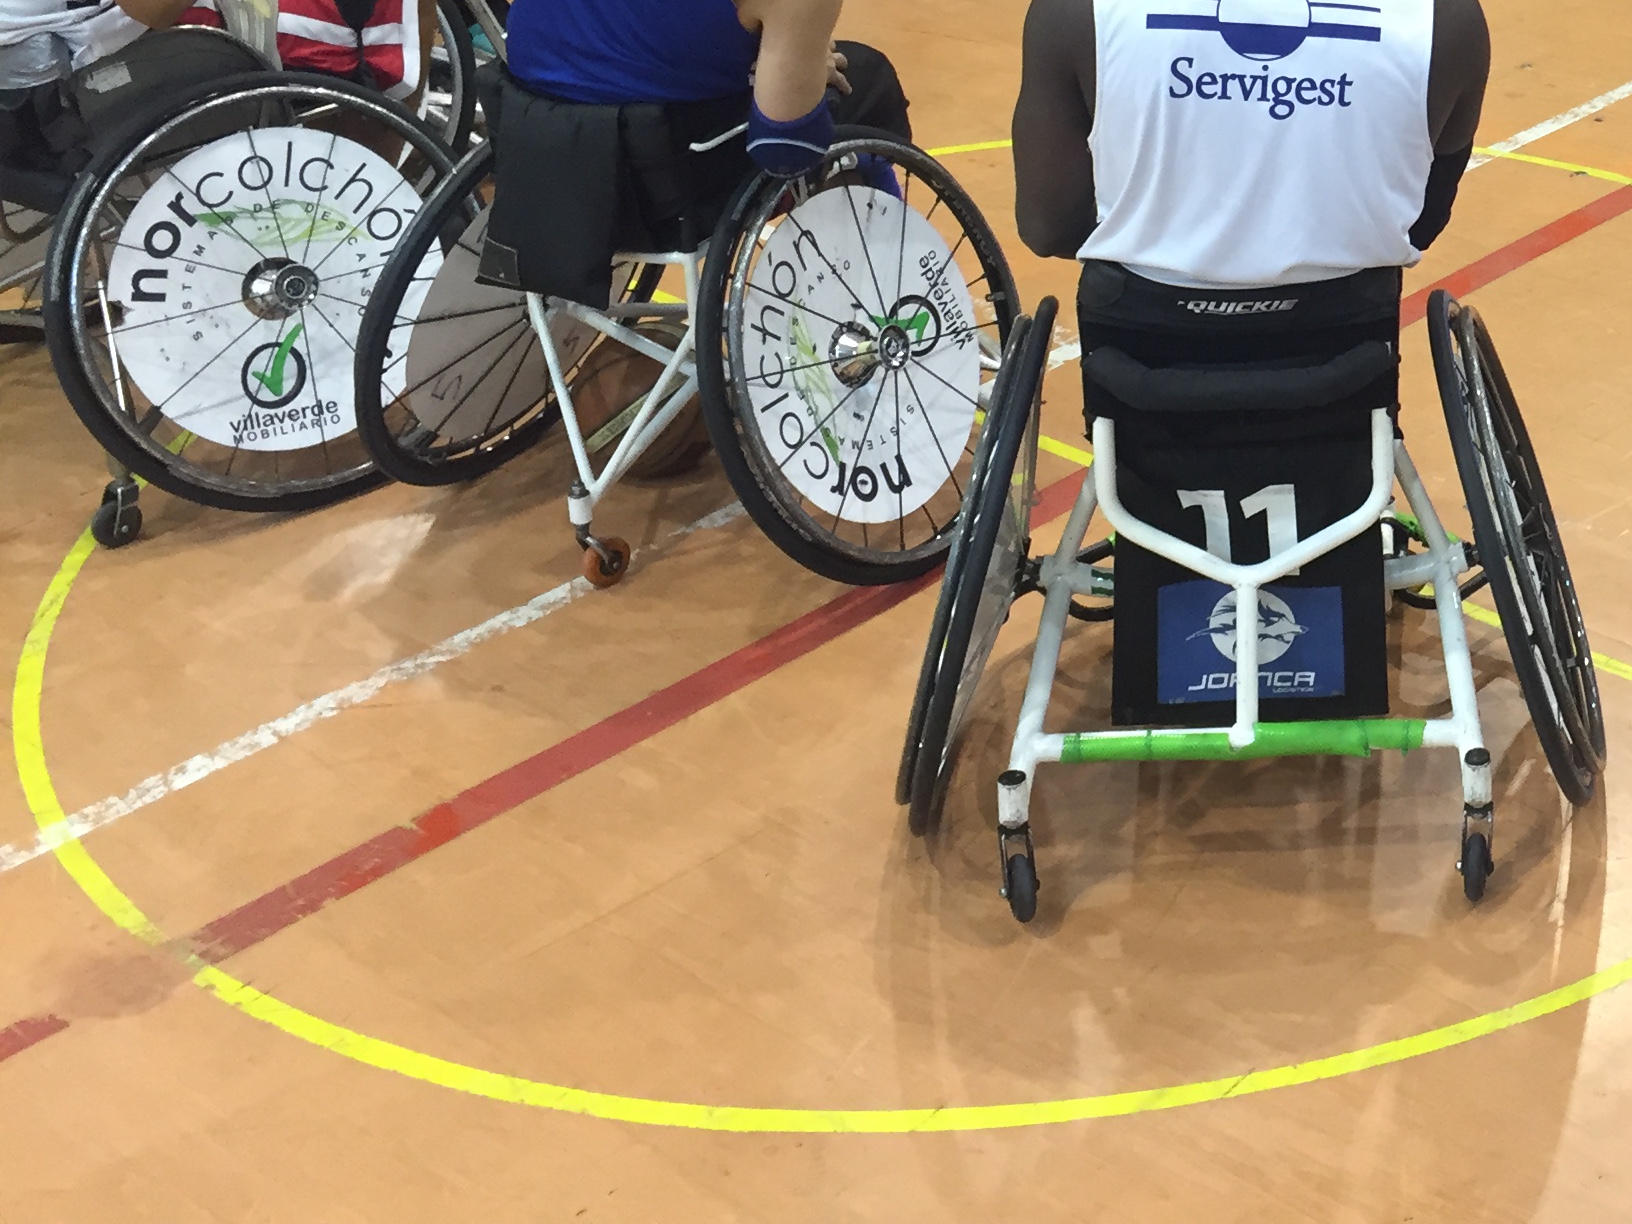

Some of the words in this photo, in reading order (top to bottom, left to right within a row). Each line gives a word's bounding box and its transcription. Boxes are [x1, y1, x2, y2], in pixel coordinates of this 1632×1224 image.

[1169, 57, 1354, 120] Servigest
[131, 141, 417, 304] norcolchó
[919, 253, 966, 351] villaverde
[1187, 299, 1298, 314] QUICKIE
[229, 399, 339, 435] villaverde
[232, 413, 341, 445] MOBILIARIO
[1177, 484, 1300, 576] 11
